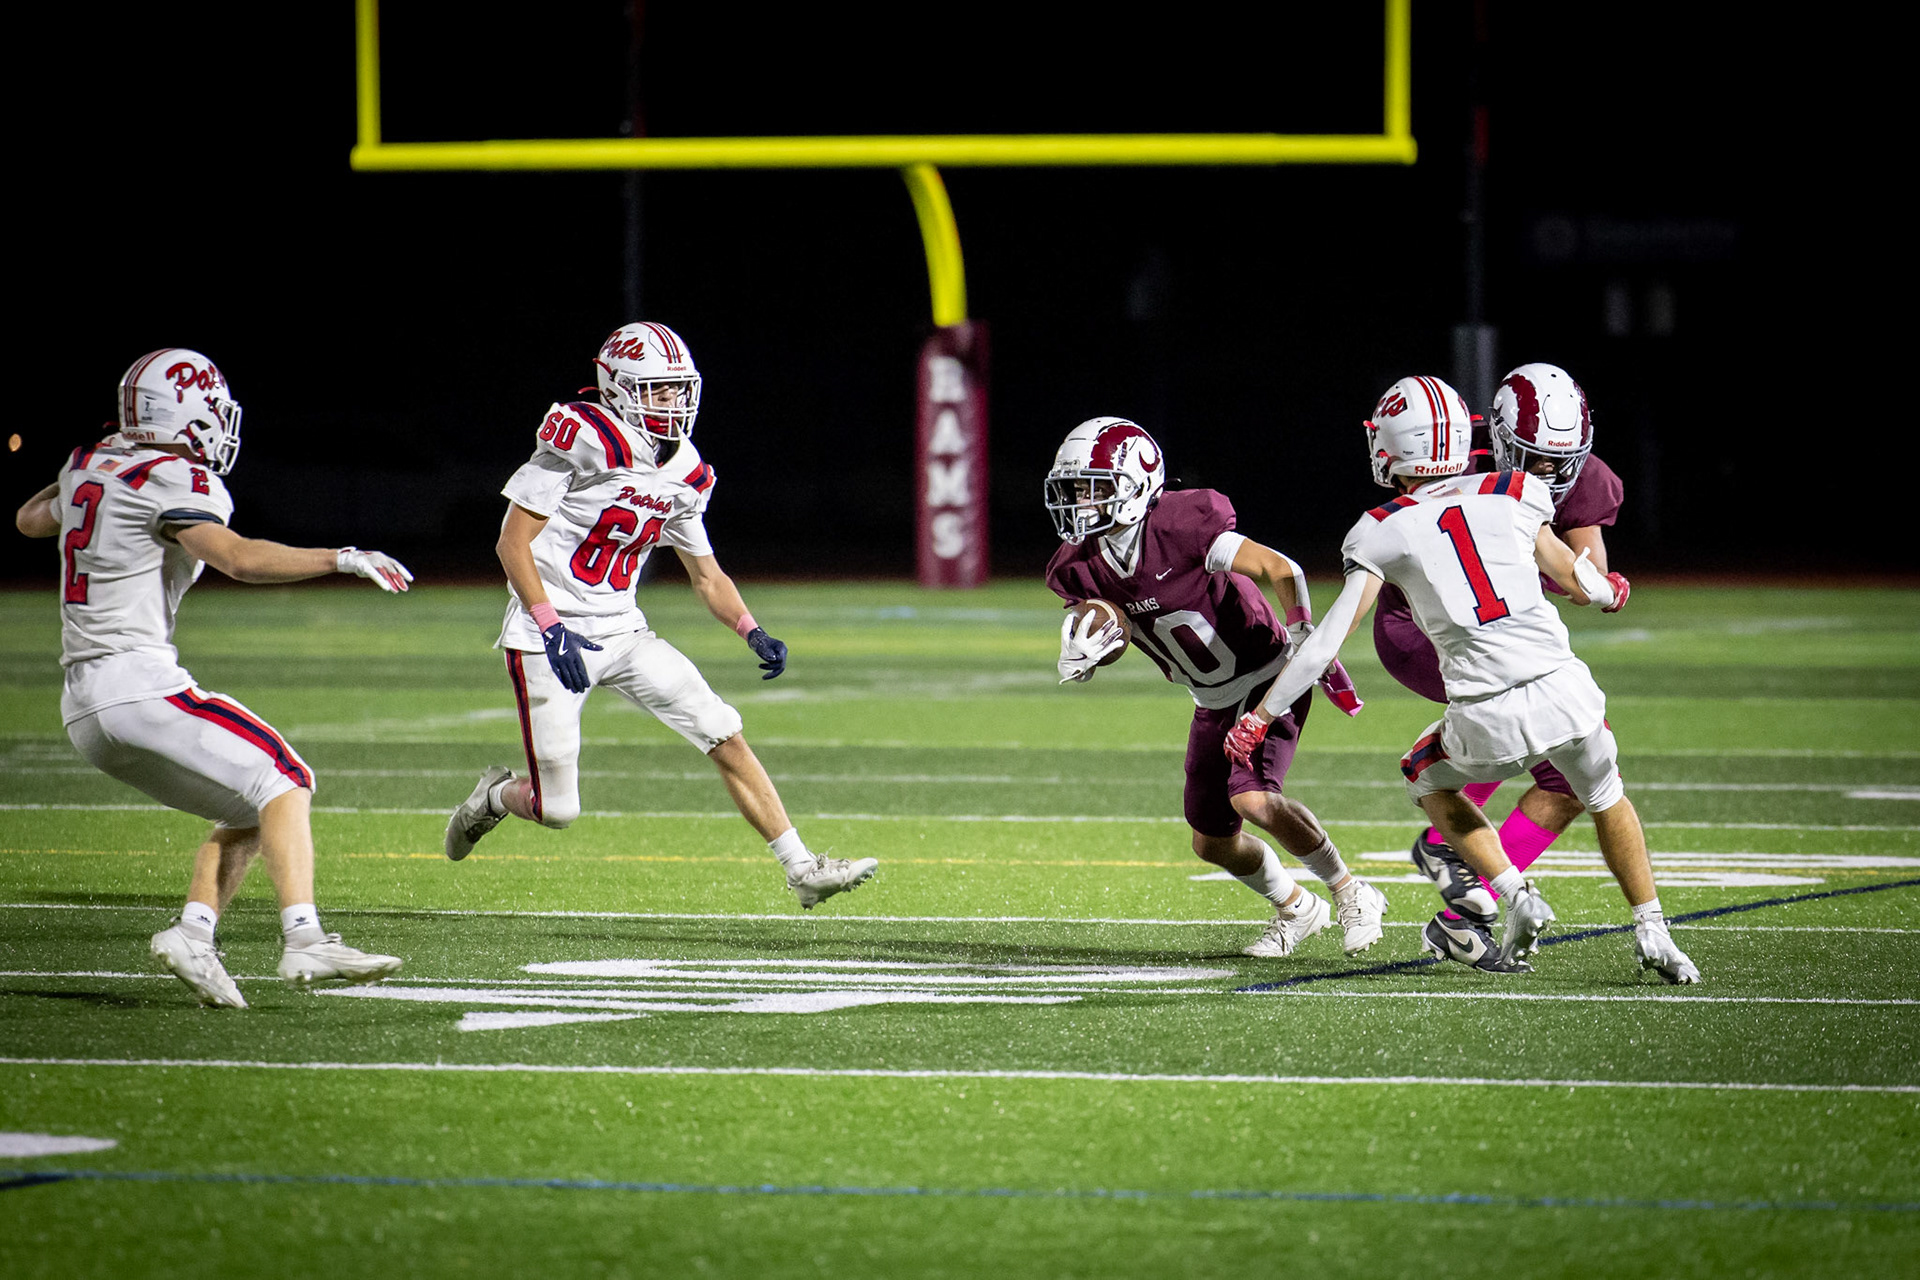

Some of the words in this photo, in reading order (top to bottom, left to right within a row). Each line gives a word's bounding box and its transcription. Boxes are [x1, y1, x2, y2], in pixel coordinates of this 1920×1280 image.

[1372, 391, 1408, 418] ts
[539, 410, 582, 452] 60
[928, 355, 971, 559] RAMS
[1414, 463, 1463, 475] Riddell
[190, 466, 210, 496] 2
[64, 480, 105, 606] 2
[569, 504, 667, 592] 60
[1437, 504, 1511, 626] 1
[1126, 597, 1161, 615] RAMS
